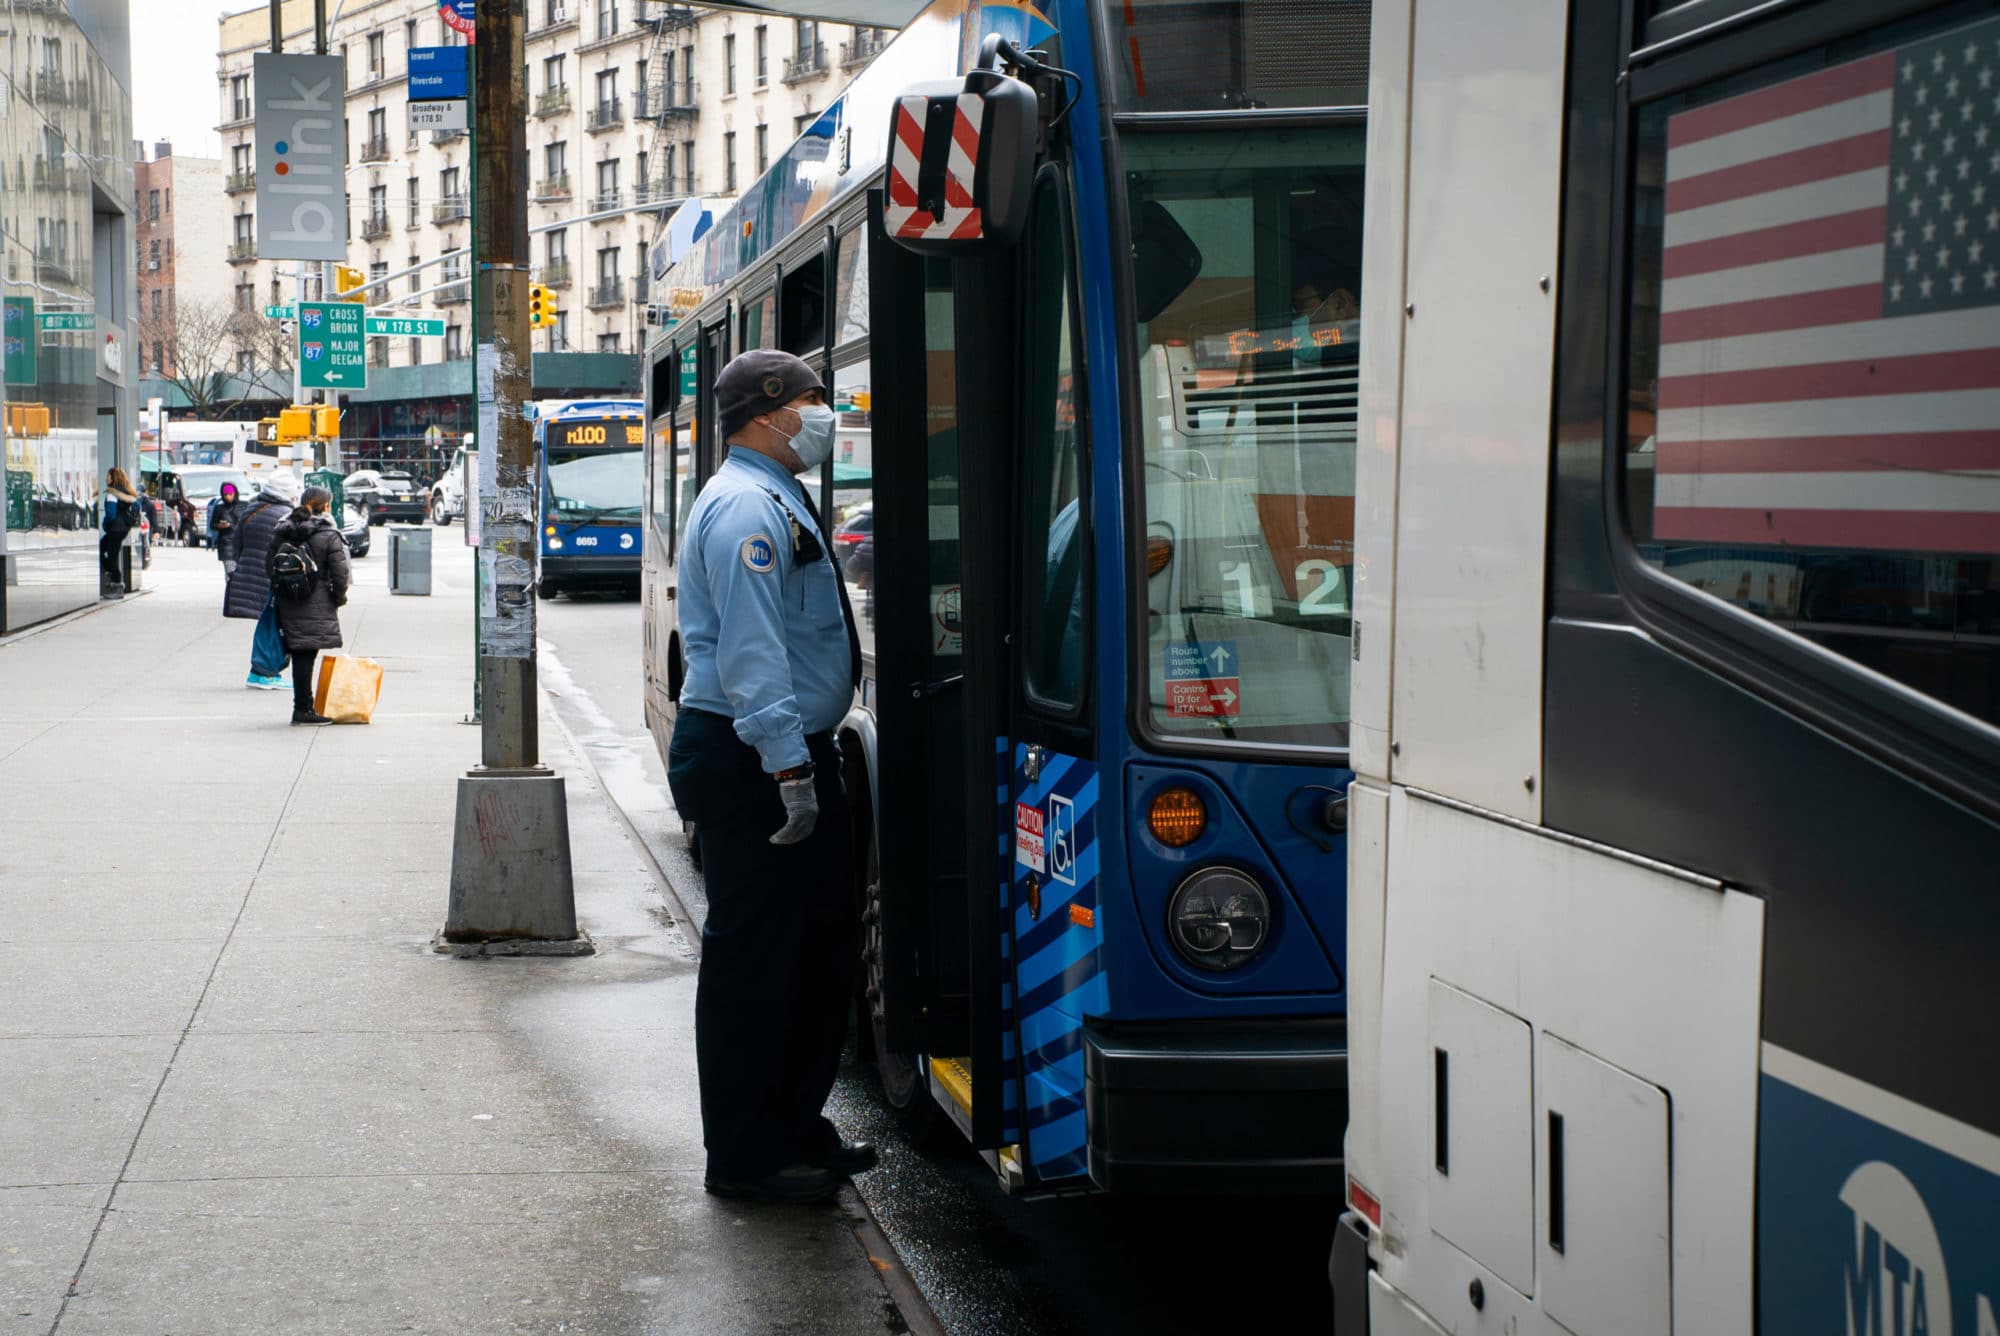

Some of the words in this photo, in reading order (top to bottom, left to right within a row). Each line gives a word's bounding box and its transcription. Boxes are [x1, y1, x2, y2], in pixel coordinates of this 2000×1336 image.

[444, 9, 457, 24] NO
[411, 51, 435, 60] Inwood
[411, 76, 443, 85] Riverdale
[412, 103, 445, 114] Broadway
[446, 103, 452, 111] &
[421, 115, 434, 123] 178
[435, 114, 443, 122] St
[266, 75, 334, 242] blink
[330, 308, 358, 321] CROSS
[303, 315, 321, 327] 95
[330, 323, 359, 334] BRONX
[376, 321, 387, 331] W
[392, 321, 411, 332] 178
[416, 321, 428, 333] St
[331, 340, 360, 351] MAJOR
[305, 347, 321, 359] 87
[331, 354, 363, 365] DEEGAN
[750, 545, 769, 560] MTA
[1295, 559, 1345, 615] 2
[1171, 647, 1199, 656] Route
[1171, 656, 1207, 666] number
[1172, 667, 1200, 676] above
[1173, 685, 1207, 694] Control
[1174, 695, 1184, 704] ID
[1187, 695, 1201, 703] for
[1174, 705, 1195, 713] MTA
[1016, 805, 1044, 836] CAUTION
